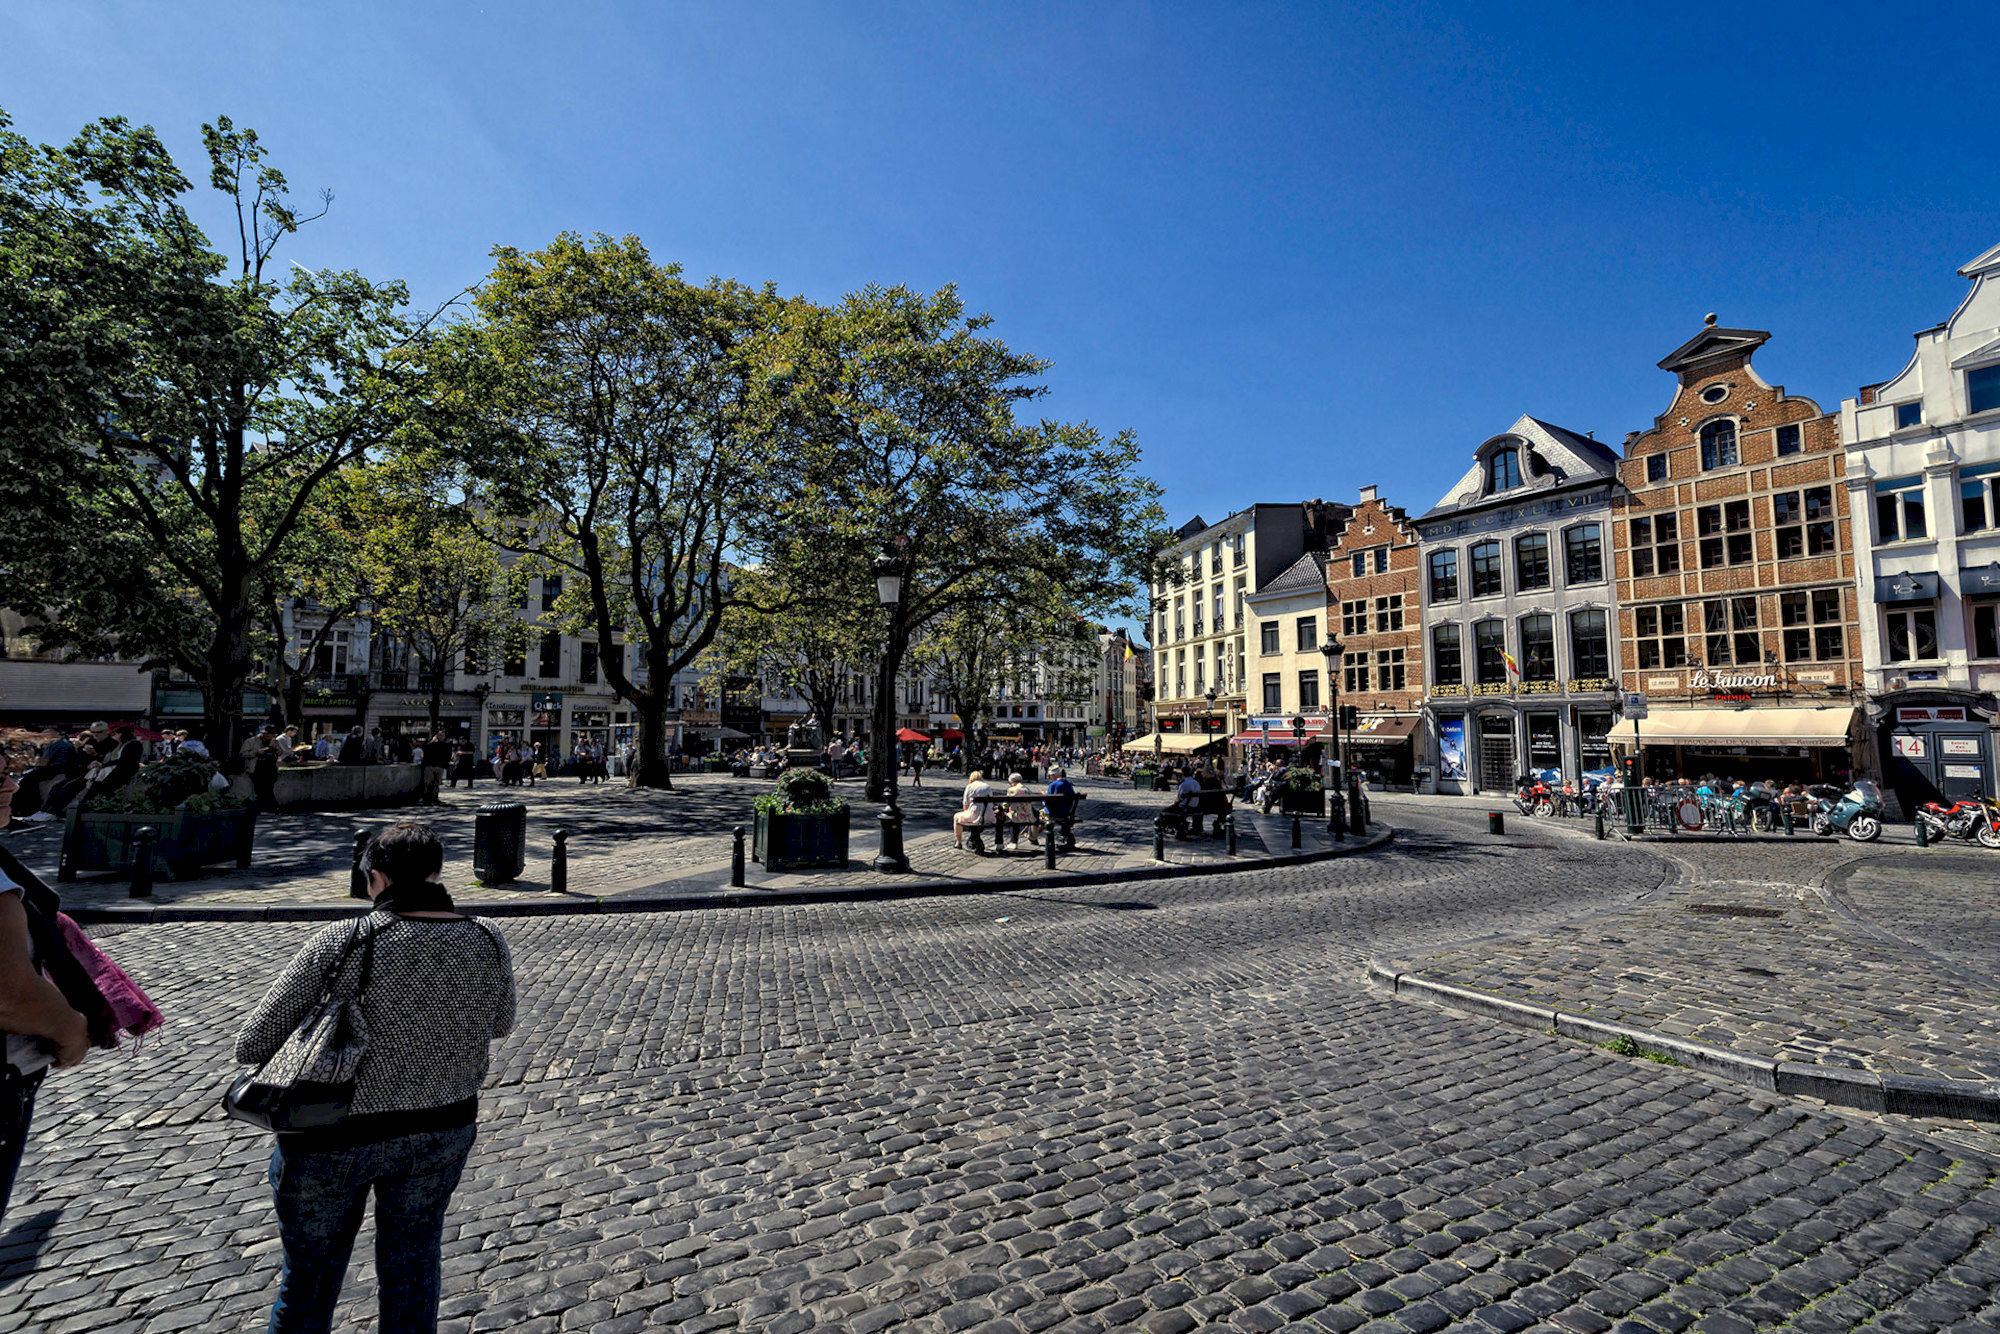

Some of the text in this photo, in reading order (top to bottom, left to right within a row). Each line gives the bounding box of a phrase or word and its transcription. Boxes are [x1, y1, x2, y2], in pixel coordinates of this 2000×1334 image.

[1687, 670, 1778, 689] Le Faucon
[1715, 693, 1752, 701] PRIMUS
[1895, 738, 1921, 755] 14
